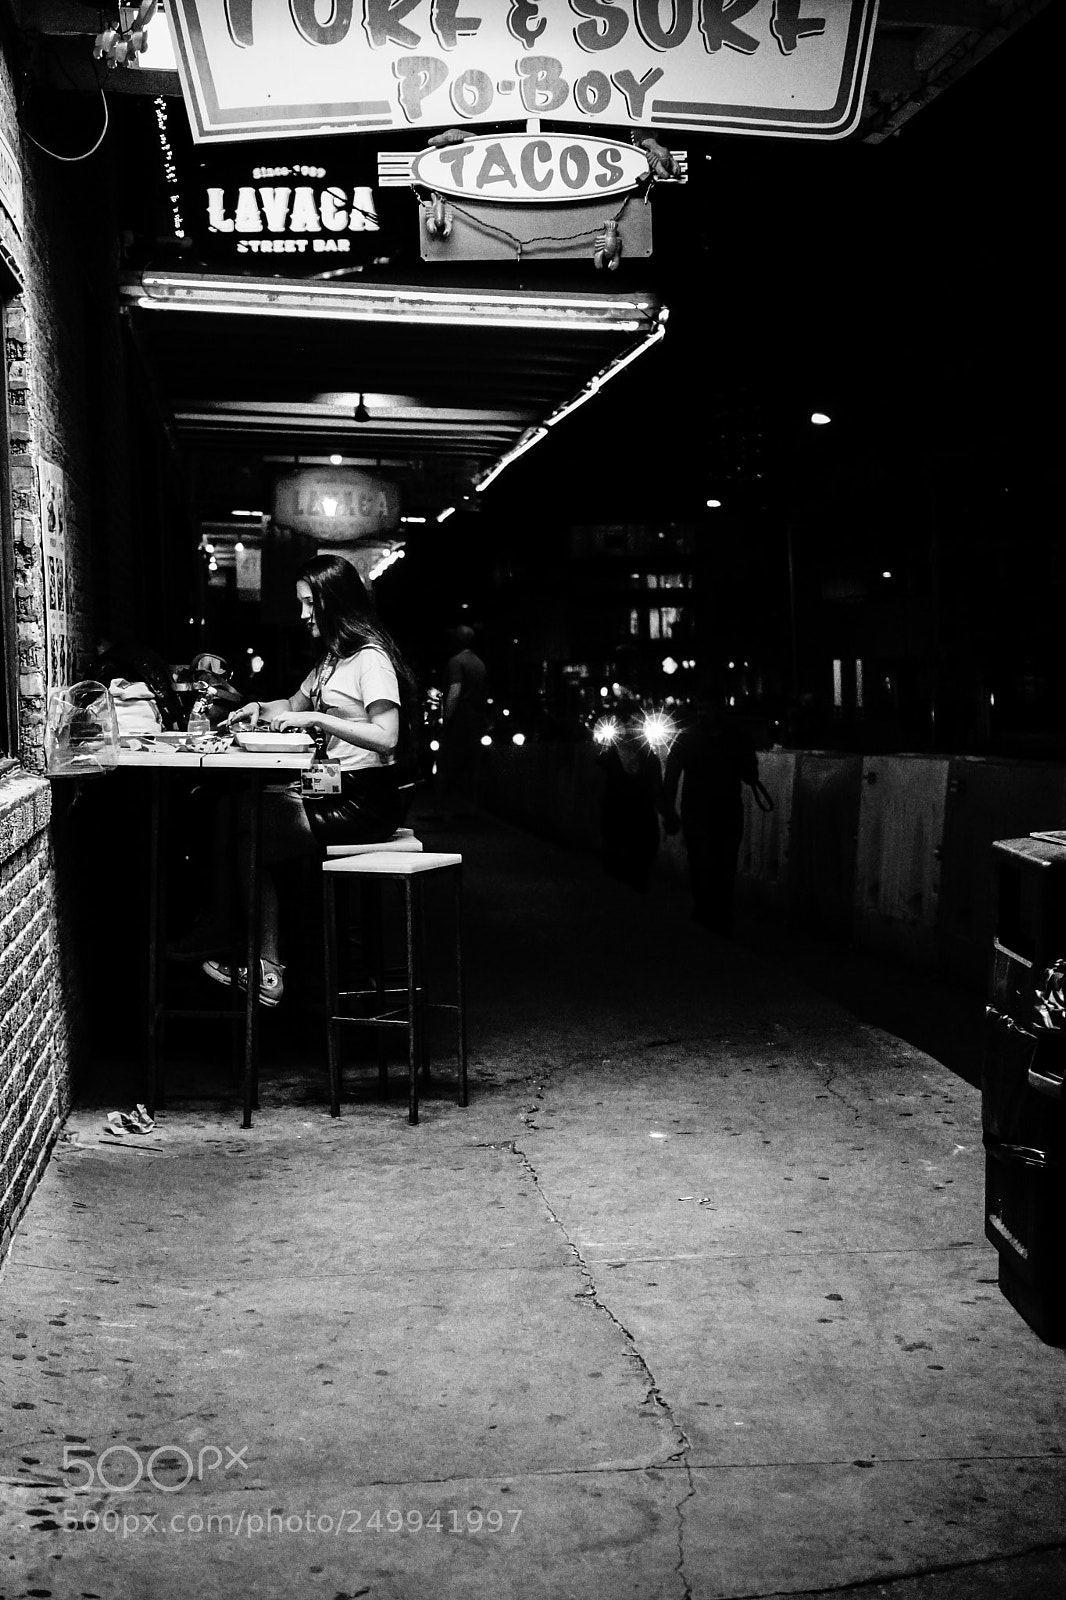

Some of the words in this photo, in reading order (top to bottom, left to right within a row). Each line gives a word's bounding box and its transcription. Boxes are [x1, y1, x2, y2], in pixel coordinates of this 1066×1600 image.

[568, 0, 826, 55] SURF
[391, 55, 664, 123] PO-BOY
[439, 140, 624, 191] TACOS
[206, 187, 380, 232] LAVACA
[237, 239, 308, 253] STREET
[313, 239, 350, 252] BAR
[293, 489, 388, 516] LAACA
